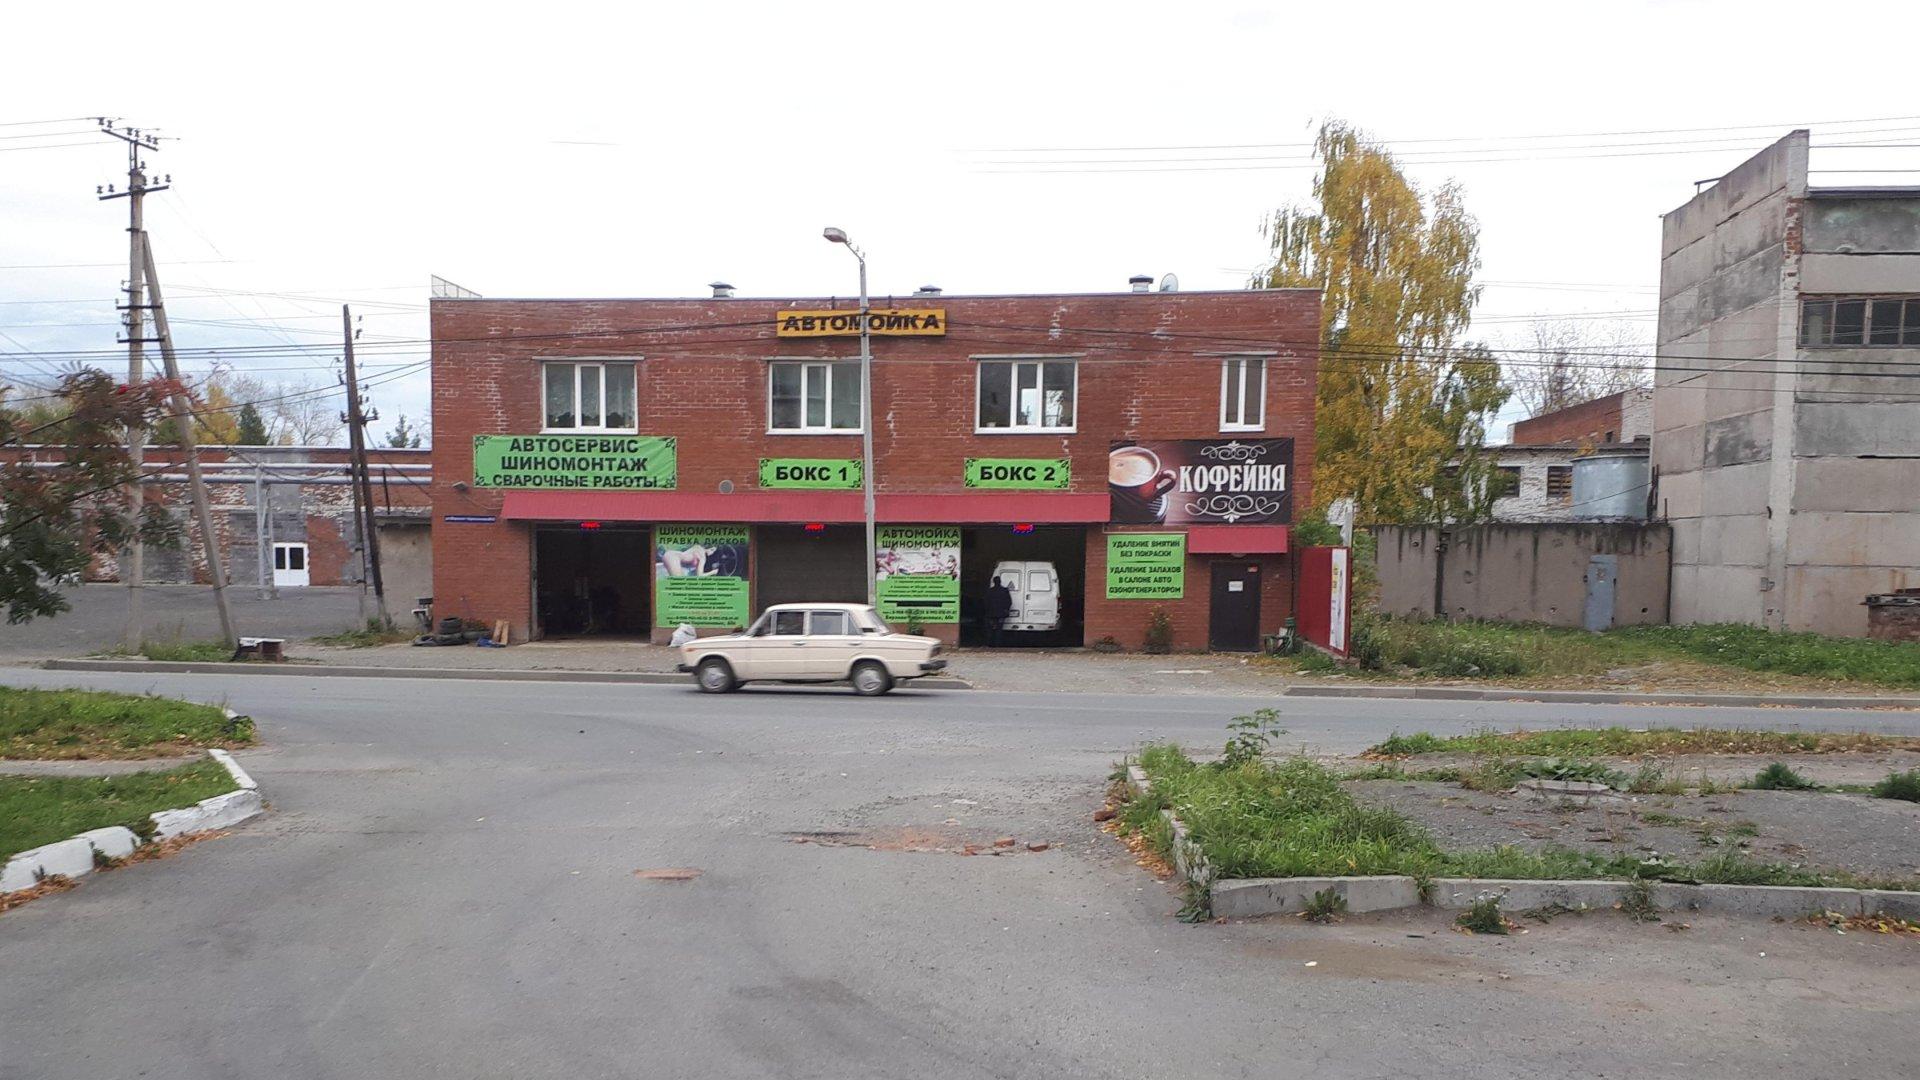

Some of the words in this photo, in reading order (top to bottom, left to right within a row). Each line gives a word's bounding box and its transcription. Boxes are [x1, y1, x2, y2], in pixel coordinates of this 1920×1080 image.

[782, 311, 940, 331] АВТОМОЙКА
[509, 438, 640, 454] АВТОСЕРВИС
[501, 456, 648, 472] ШИНОМОНТАЖ
[775, 466, 831, 481] БОКС
[838, 466, 848, 481] 1
[979, 466, 1037, 481] БОКС
[1044, 466, 1055, 481] 2
[1179, 459, 1287, 493] КОФЕЙНЯ
[492, 474, 588, 487] СВАРОЧНЫЕ
[593, 475, 658, 488] РАБОТЫ
[659, 527, 746, 536] ШИНОМОНТАЖ
[882, 528, 960, 538] АВТОМОЙКА
[659, 537, 699, 545] ПРАВКА
[704, 537, 746, 545] ДИСКОВ
[882, 540, 959, 549] ШИНОМОНТАЖ
[1112, 540, 1149, 548] УДАЛЕНИЕ
[1110, 566, 1147, 574] УДАЛЕНИЕ
